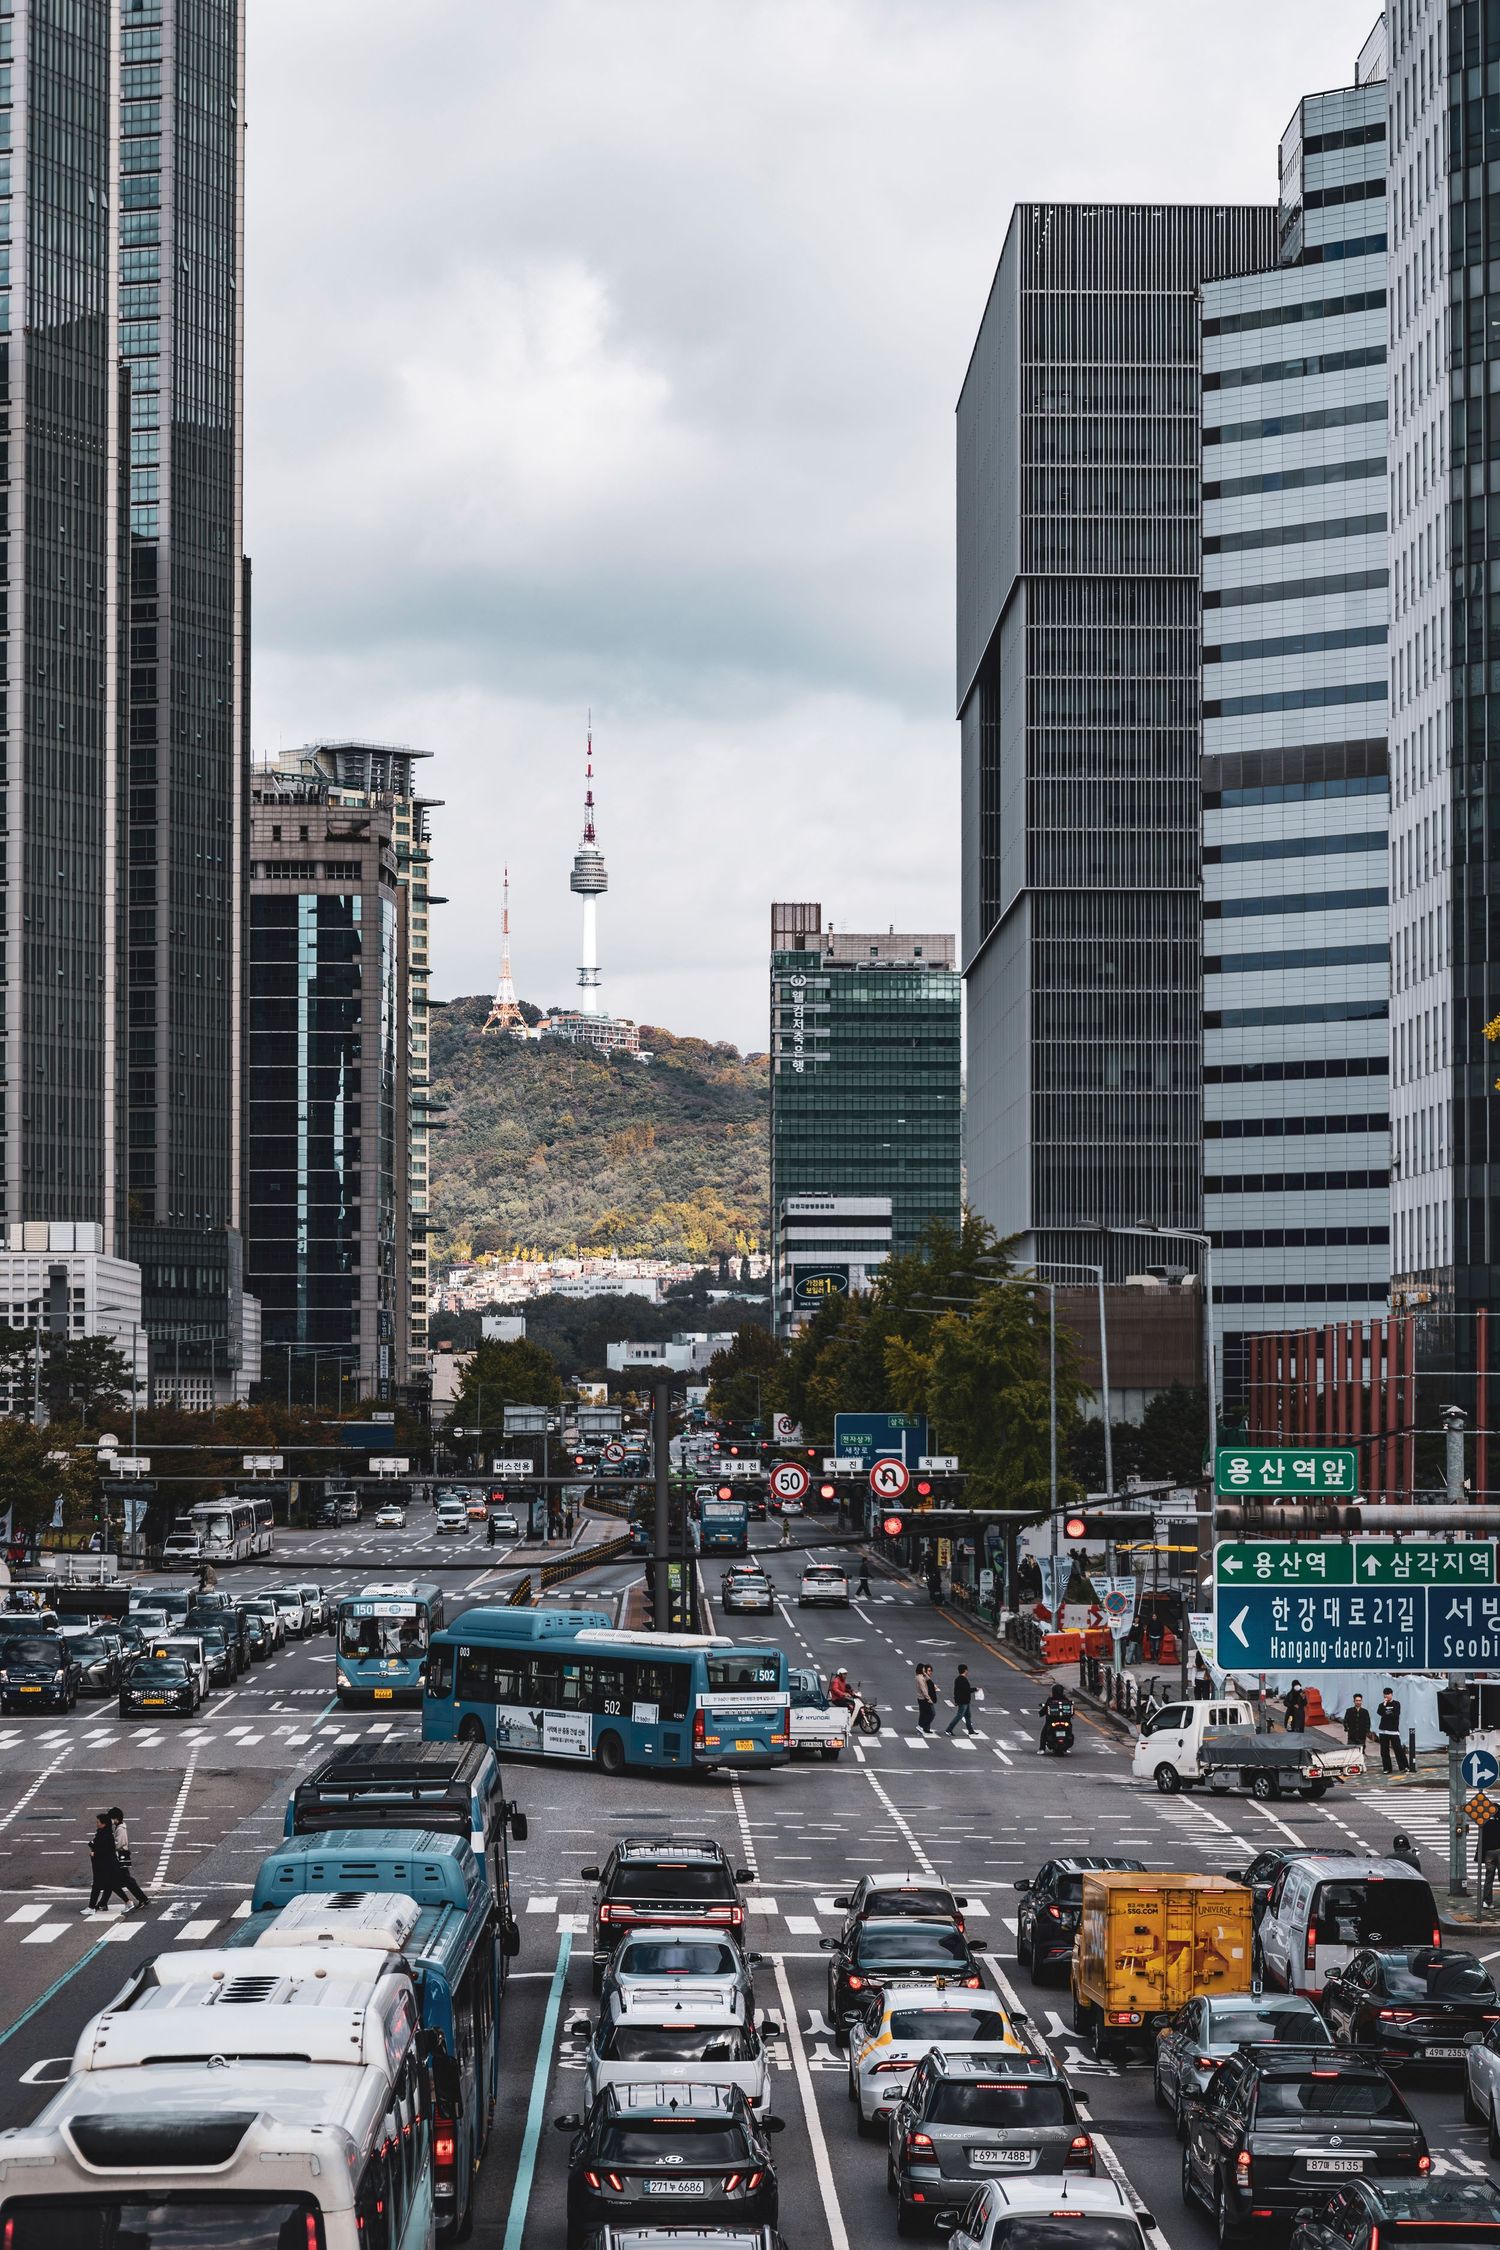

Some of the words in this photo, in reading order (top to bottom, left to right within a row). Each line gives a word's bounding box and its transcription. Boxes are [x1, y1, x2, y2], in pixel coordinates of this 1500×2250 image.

[792, 990, 804, 1073] 웰컴저축은행
[842, 1436, 871, 1444] 전자상가
[496, 1462, 530, 1471] 버스전용
[725, 1463, 757, 1471] 좌회전
[1227, 1458, 1346, 1485] 용산역앞
[780, 1473, 800, 1491] 50
[1253, 1552, 1326, 1578] 용산역
[1390, 1553, 1489, 1578] 삼각지역
[356, 1605, 373, 1614] 150
[460, 1647, 470, 1656] 003
[1271, 1637, 1372, 1663] Hangang-daero
[1376, 1637, 1415, 1662] 21-gil
[759, 1670, 775, 1681] 502
[604, 1701, 621, 1715] 502
[1198, 1906, 1232, 1915] UNIVERSE
[1002, 2151, 1025, 2160] 7488
[1335, 2161, 1358, 2170] 5135
[678, 2182, 701, 2191] 6686
